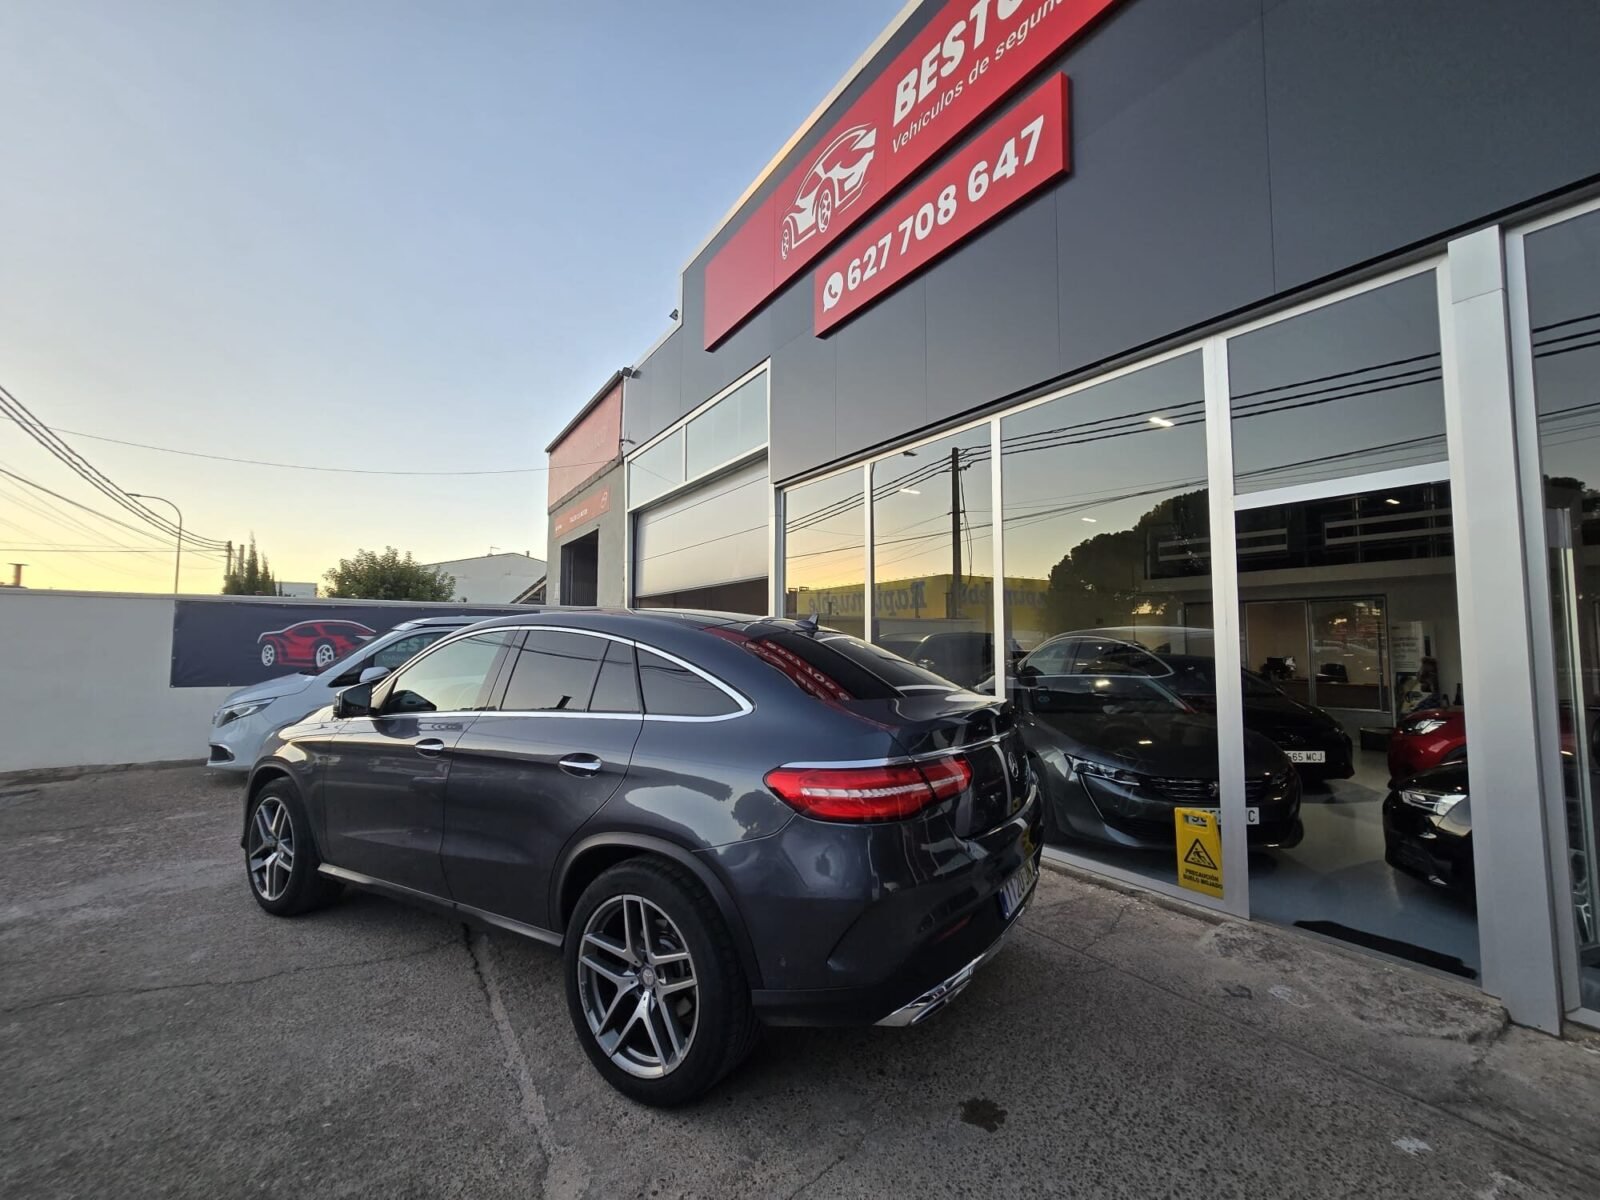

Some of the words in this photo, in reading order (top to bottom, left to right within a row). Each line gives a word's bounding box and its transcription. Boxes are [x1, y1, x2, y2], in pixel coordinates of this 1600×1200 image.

[893, 80, 964, 153] Vehículos
[968, 57, 990, 85] de
[995, 0, 1062, 61] segun
[847, 233, 894, 292] 627
[898, 185, 957, 256] 708
[967, 115, 1045, 203] 647
[1306, 752, 1323, 762] MCJ
